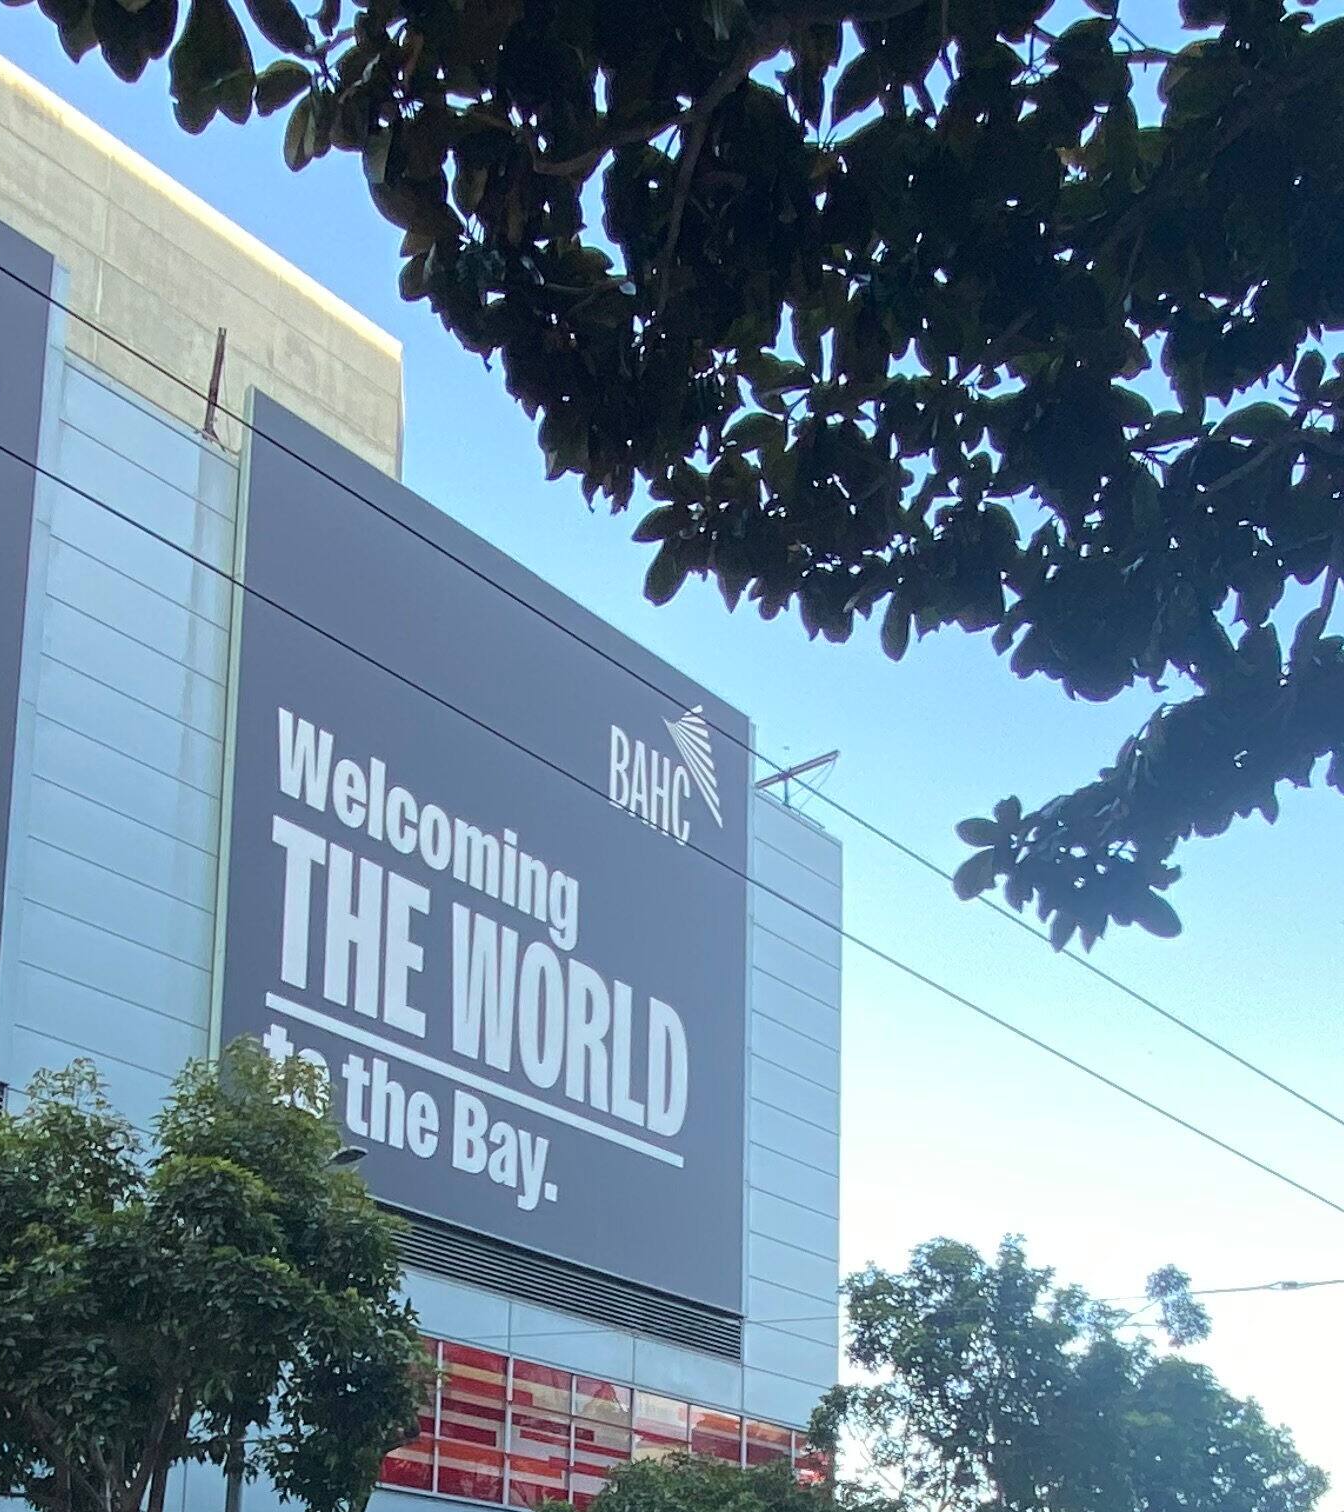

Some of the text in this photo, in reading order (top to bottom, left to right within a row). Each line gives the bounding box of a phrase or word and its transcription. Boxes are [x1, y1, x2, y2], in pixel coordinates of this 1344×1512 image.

[278, 707, 580, 951] Welcoming
[609, 725, 690, 846] BAHC
[272, 814, 689, 1138] THE WORLD
[342, 1054, 439, 1158] the
[452, 1090, 557, 1211] Bay.
